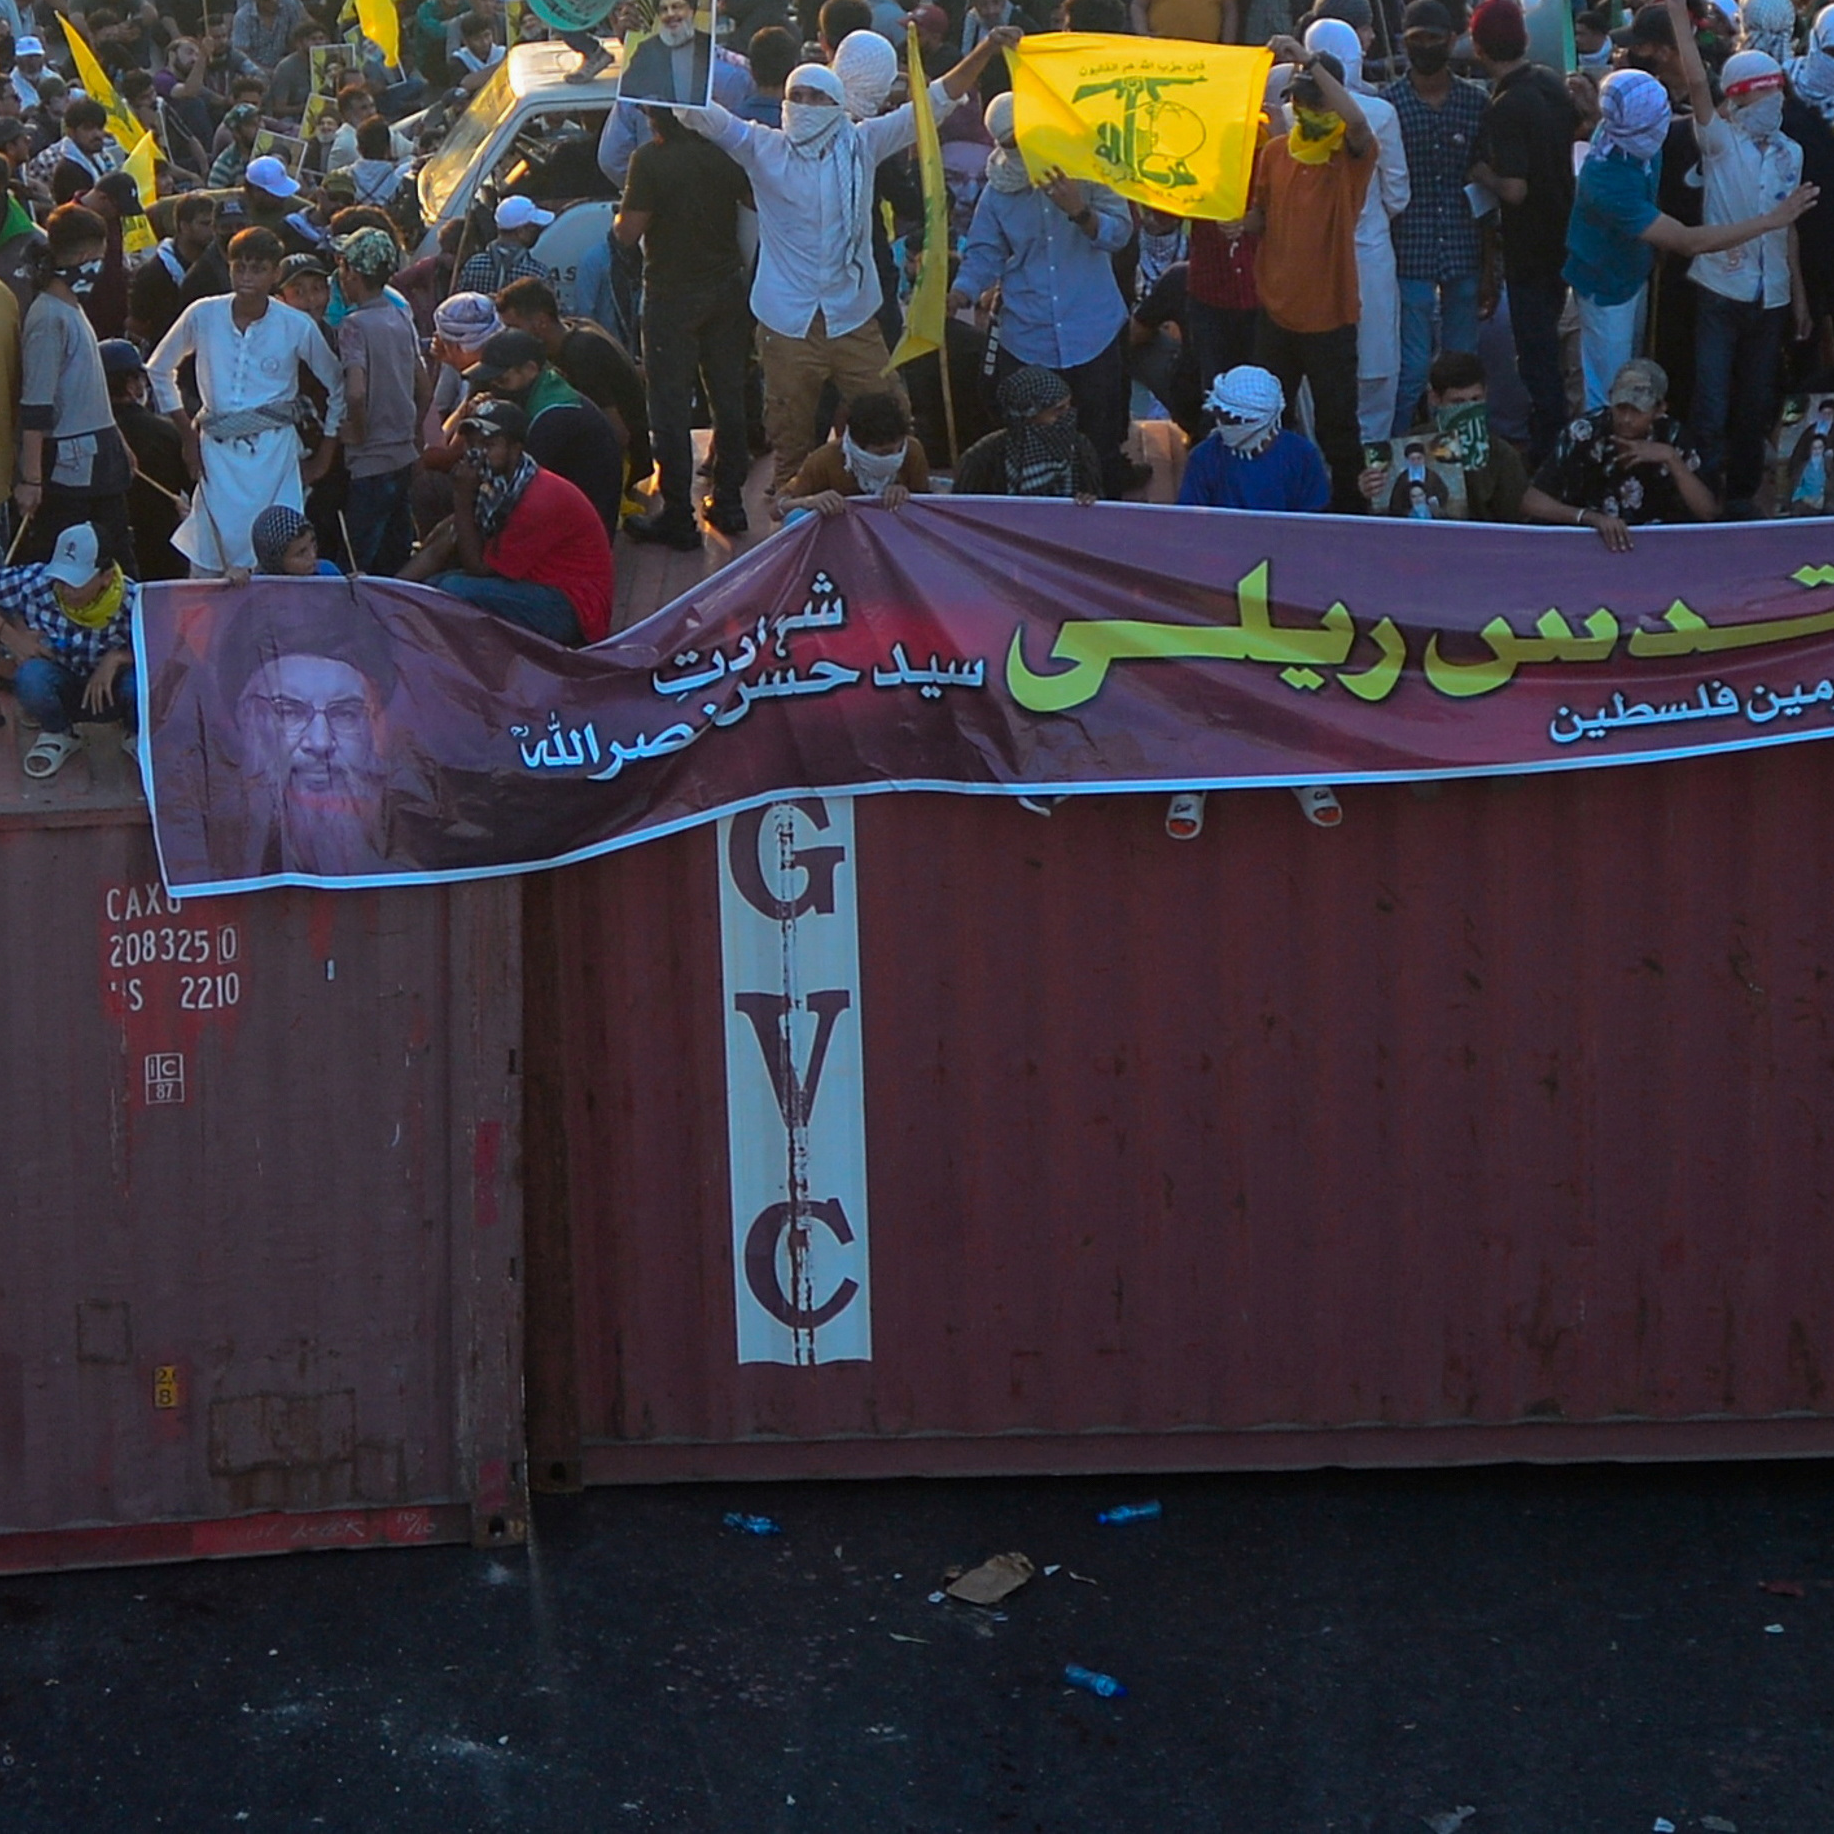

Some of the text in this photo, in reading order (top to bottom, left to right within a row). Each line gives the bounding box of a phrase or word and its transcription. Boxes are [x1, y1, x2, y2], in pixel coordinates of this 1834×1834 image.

[1007, 558, 1407, 714] ریلی
[872, 642, 985, 699] سید
[1548, 682, 1740, 744] فلسطین
[110, 927, 210, 968] 208325
[180, 972, 240, 1010] 2210
[155, 1082, 175, 1100] 87
